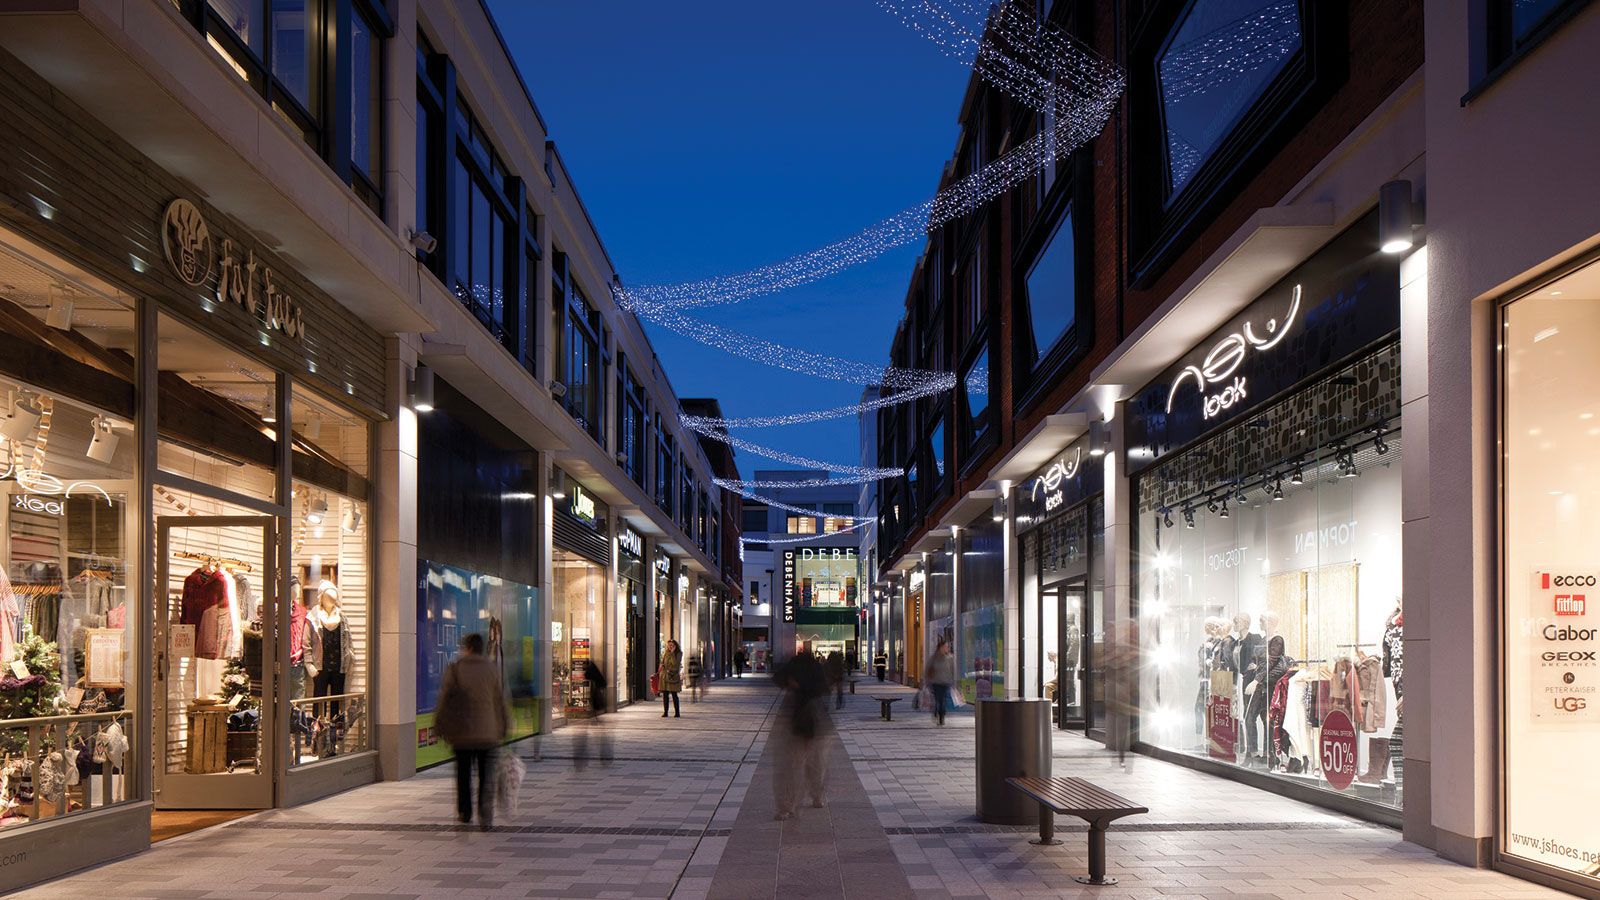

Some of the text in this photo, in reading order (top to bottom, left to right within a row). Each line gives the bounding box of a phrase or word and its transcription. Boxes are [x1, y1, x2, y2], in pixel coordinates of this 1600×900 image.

[1165, 284, 1302, 414] new
[1203, 376, 1247, 420] look
[1045, 489, 1063, 512] look
[802, 547, 854, 561] DEBE
[784, 551, 794, 622] DEBENHAMS
[1553, 575, 1597, 587] ecco
[1542, 624, 1598, 642] Gabor
[1541, 651, 1597, 662] GEOX
[1554, 697, 1587, 713] UGG
[1323, 740, 1354, 773] 50%
[1342, 764, 1354, 775] OFF
